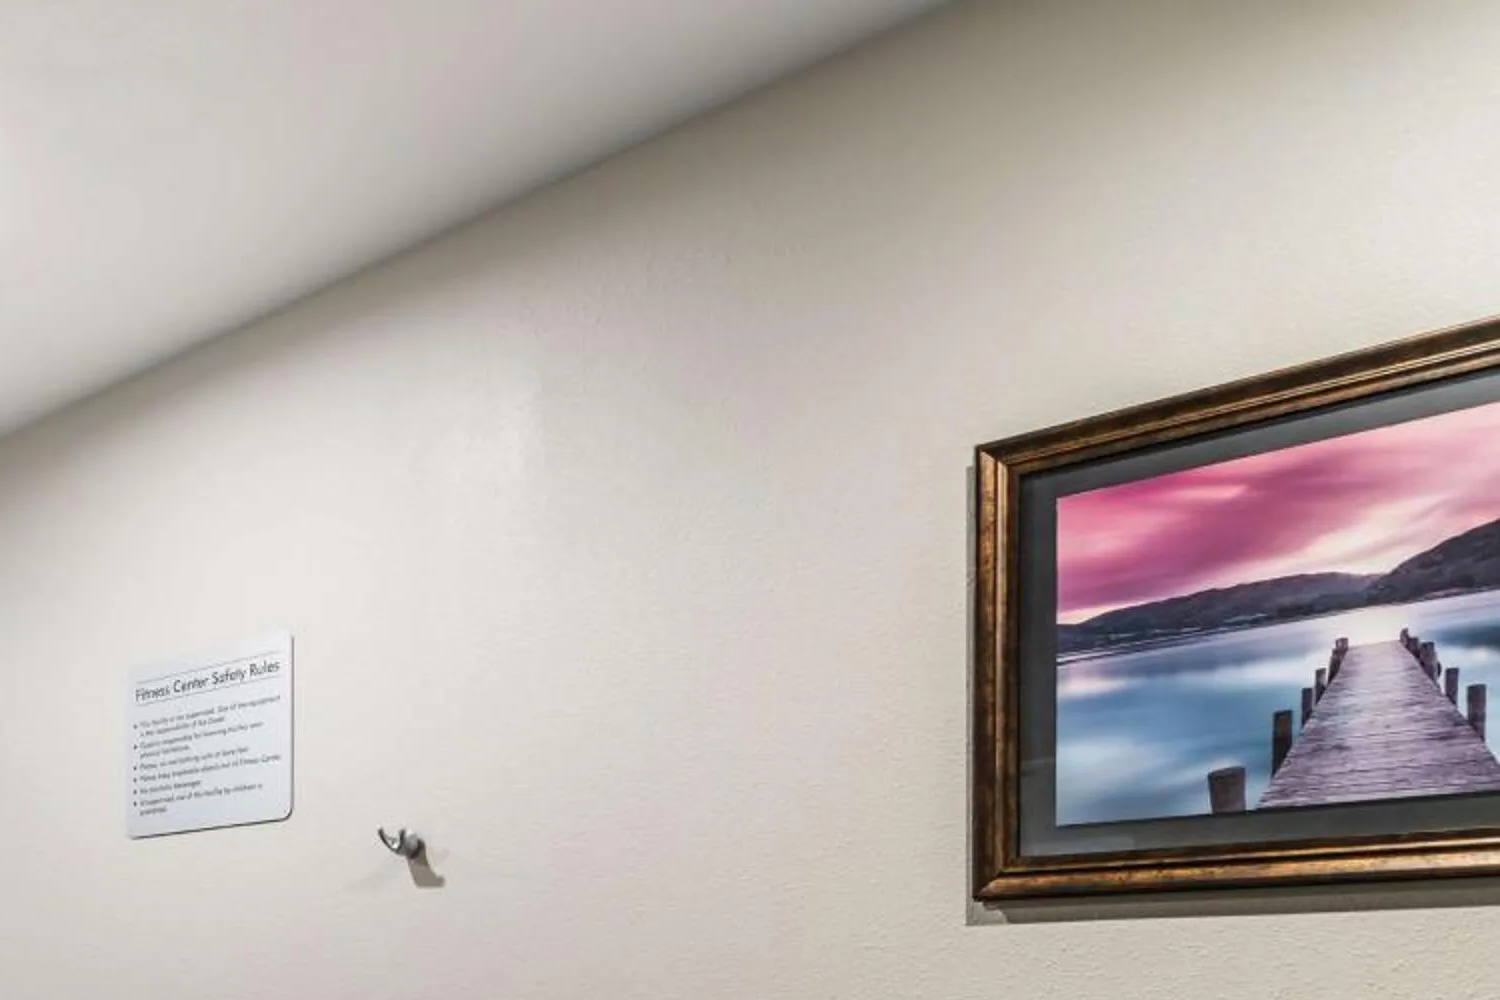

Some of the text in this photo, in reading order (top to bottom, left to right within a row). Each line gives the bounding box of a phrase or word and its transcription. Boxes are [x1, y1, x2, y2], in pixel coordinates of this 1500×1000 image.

[135, 660, 281, 701] Fitness Center Safety Rules
